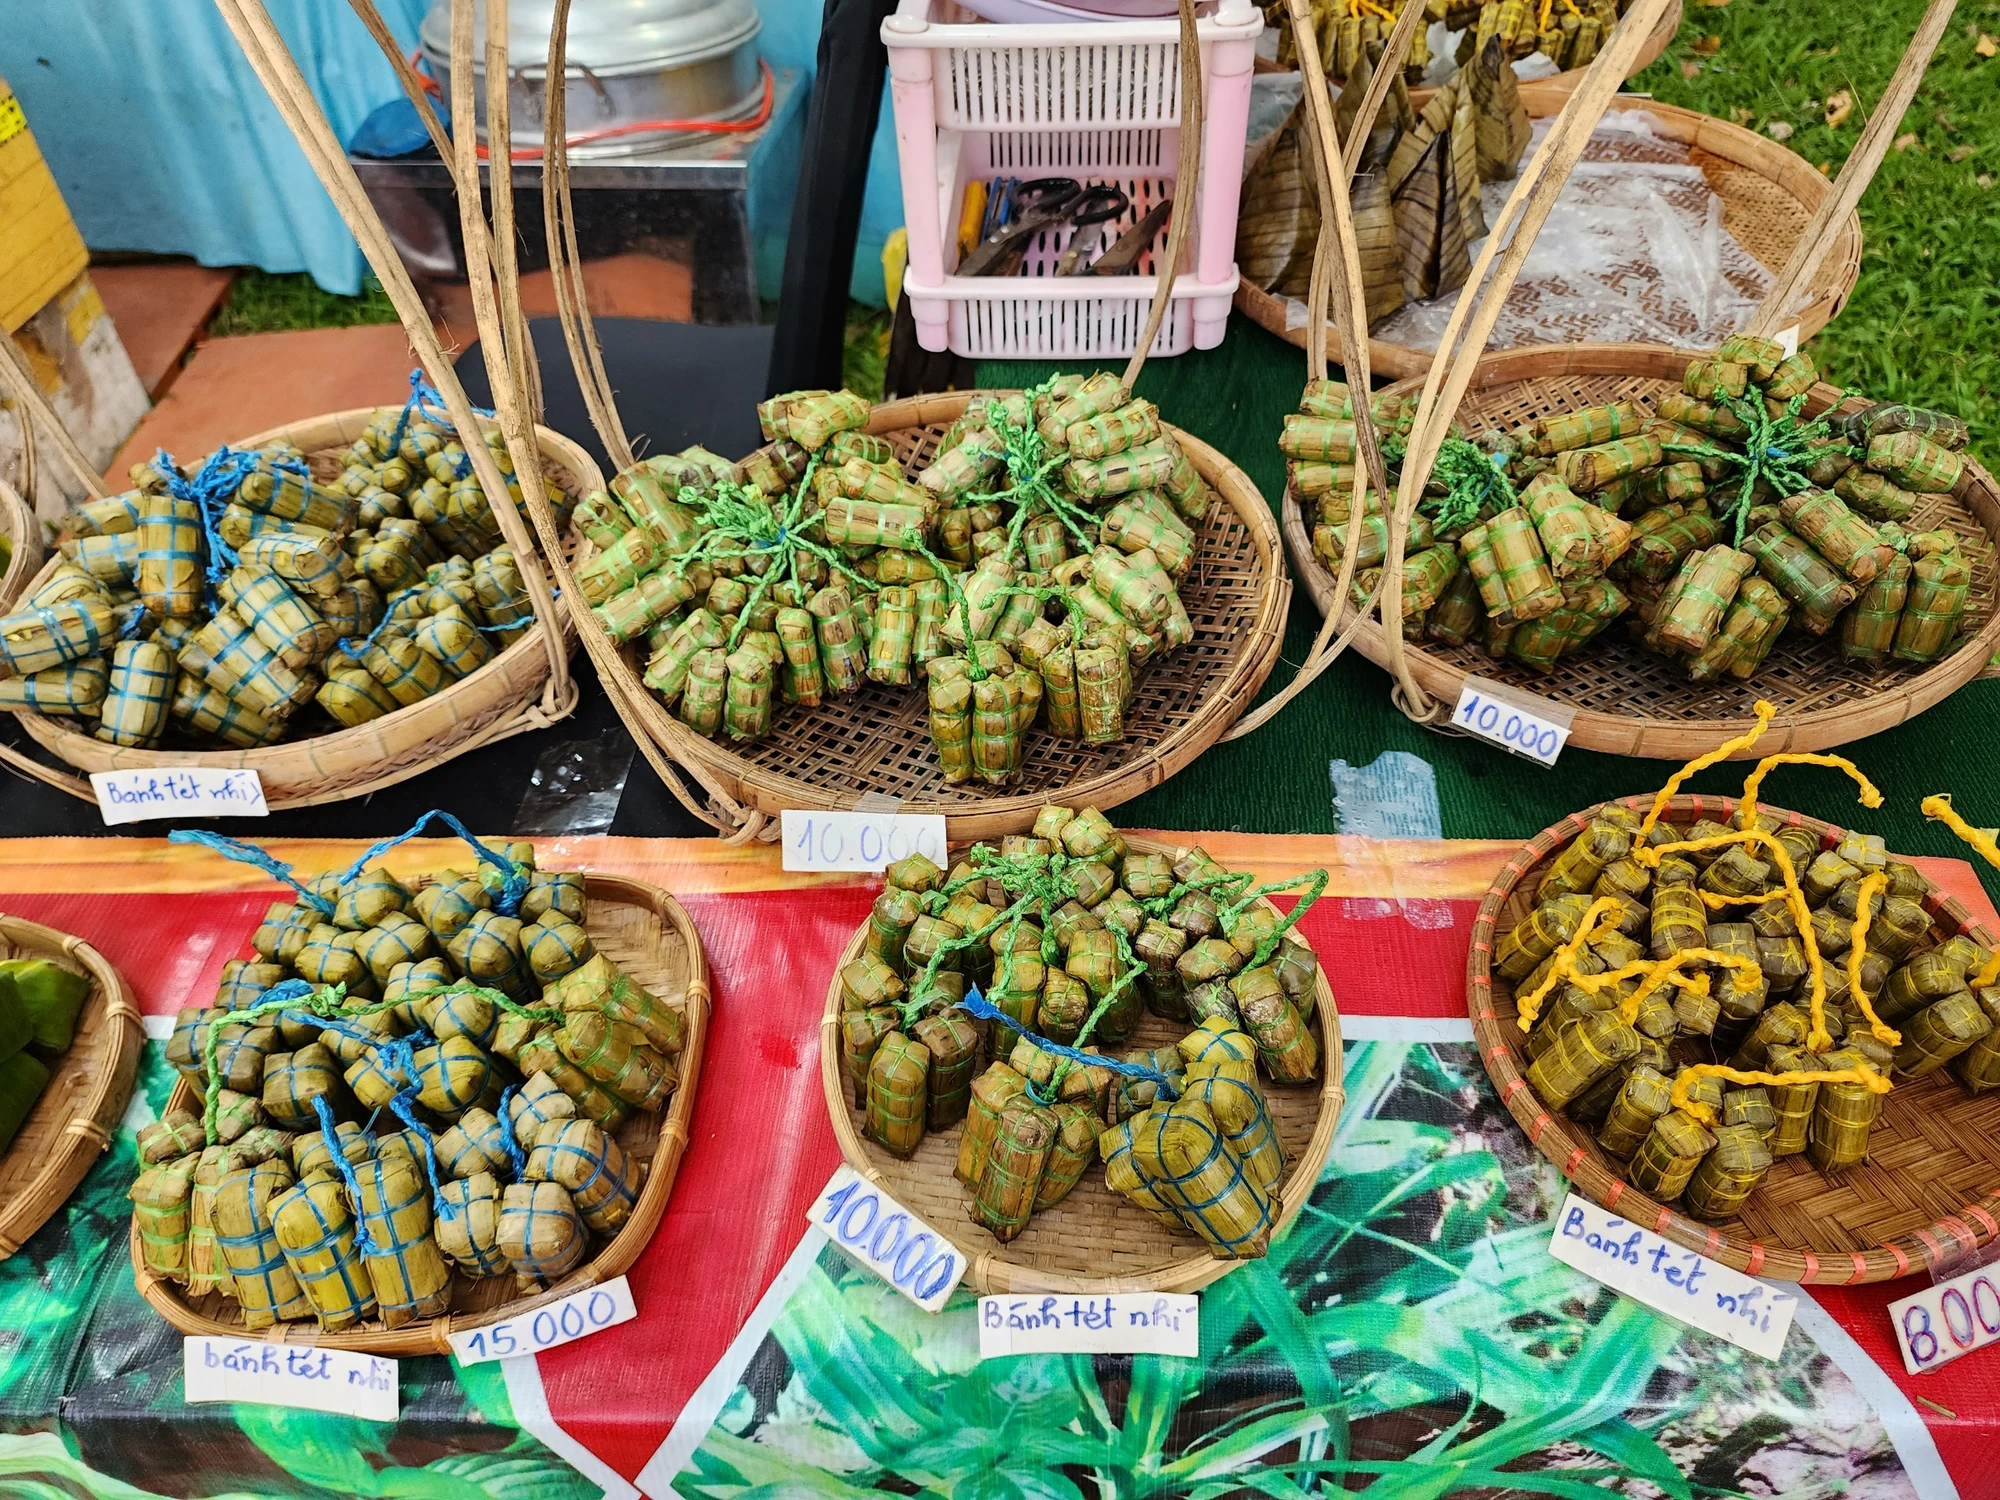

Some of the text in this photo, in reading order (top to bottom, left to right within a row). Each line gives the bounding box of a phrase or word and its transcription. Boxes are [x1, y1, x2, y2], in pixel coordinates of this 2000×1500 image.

[1463, 695, 1558, 757] 10.000
[106, 775, 165, 804] Bánh
[797, 818, 939, 863] 10.000
[823, 1180, 956, 1301] 10.000
[1562, 1206, 1643, 1266] Bánh
[1648, 1244, 1707, 1295] tét
[468, 1290, 617, 1357] 15.000
[984, 1296, 1061, 1330] Bánh
[204, 1341, 281, 1375] bánh
